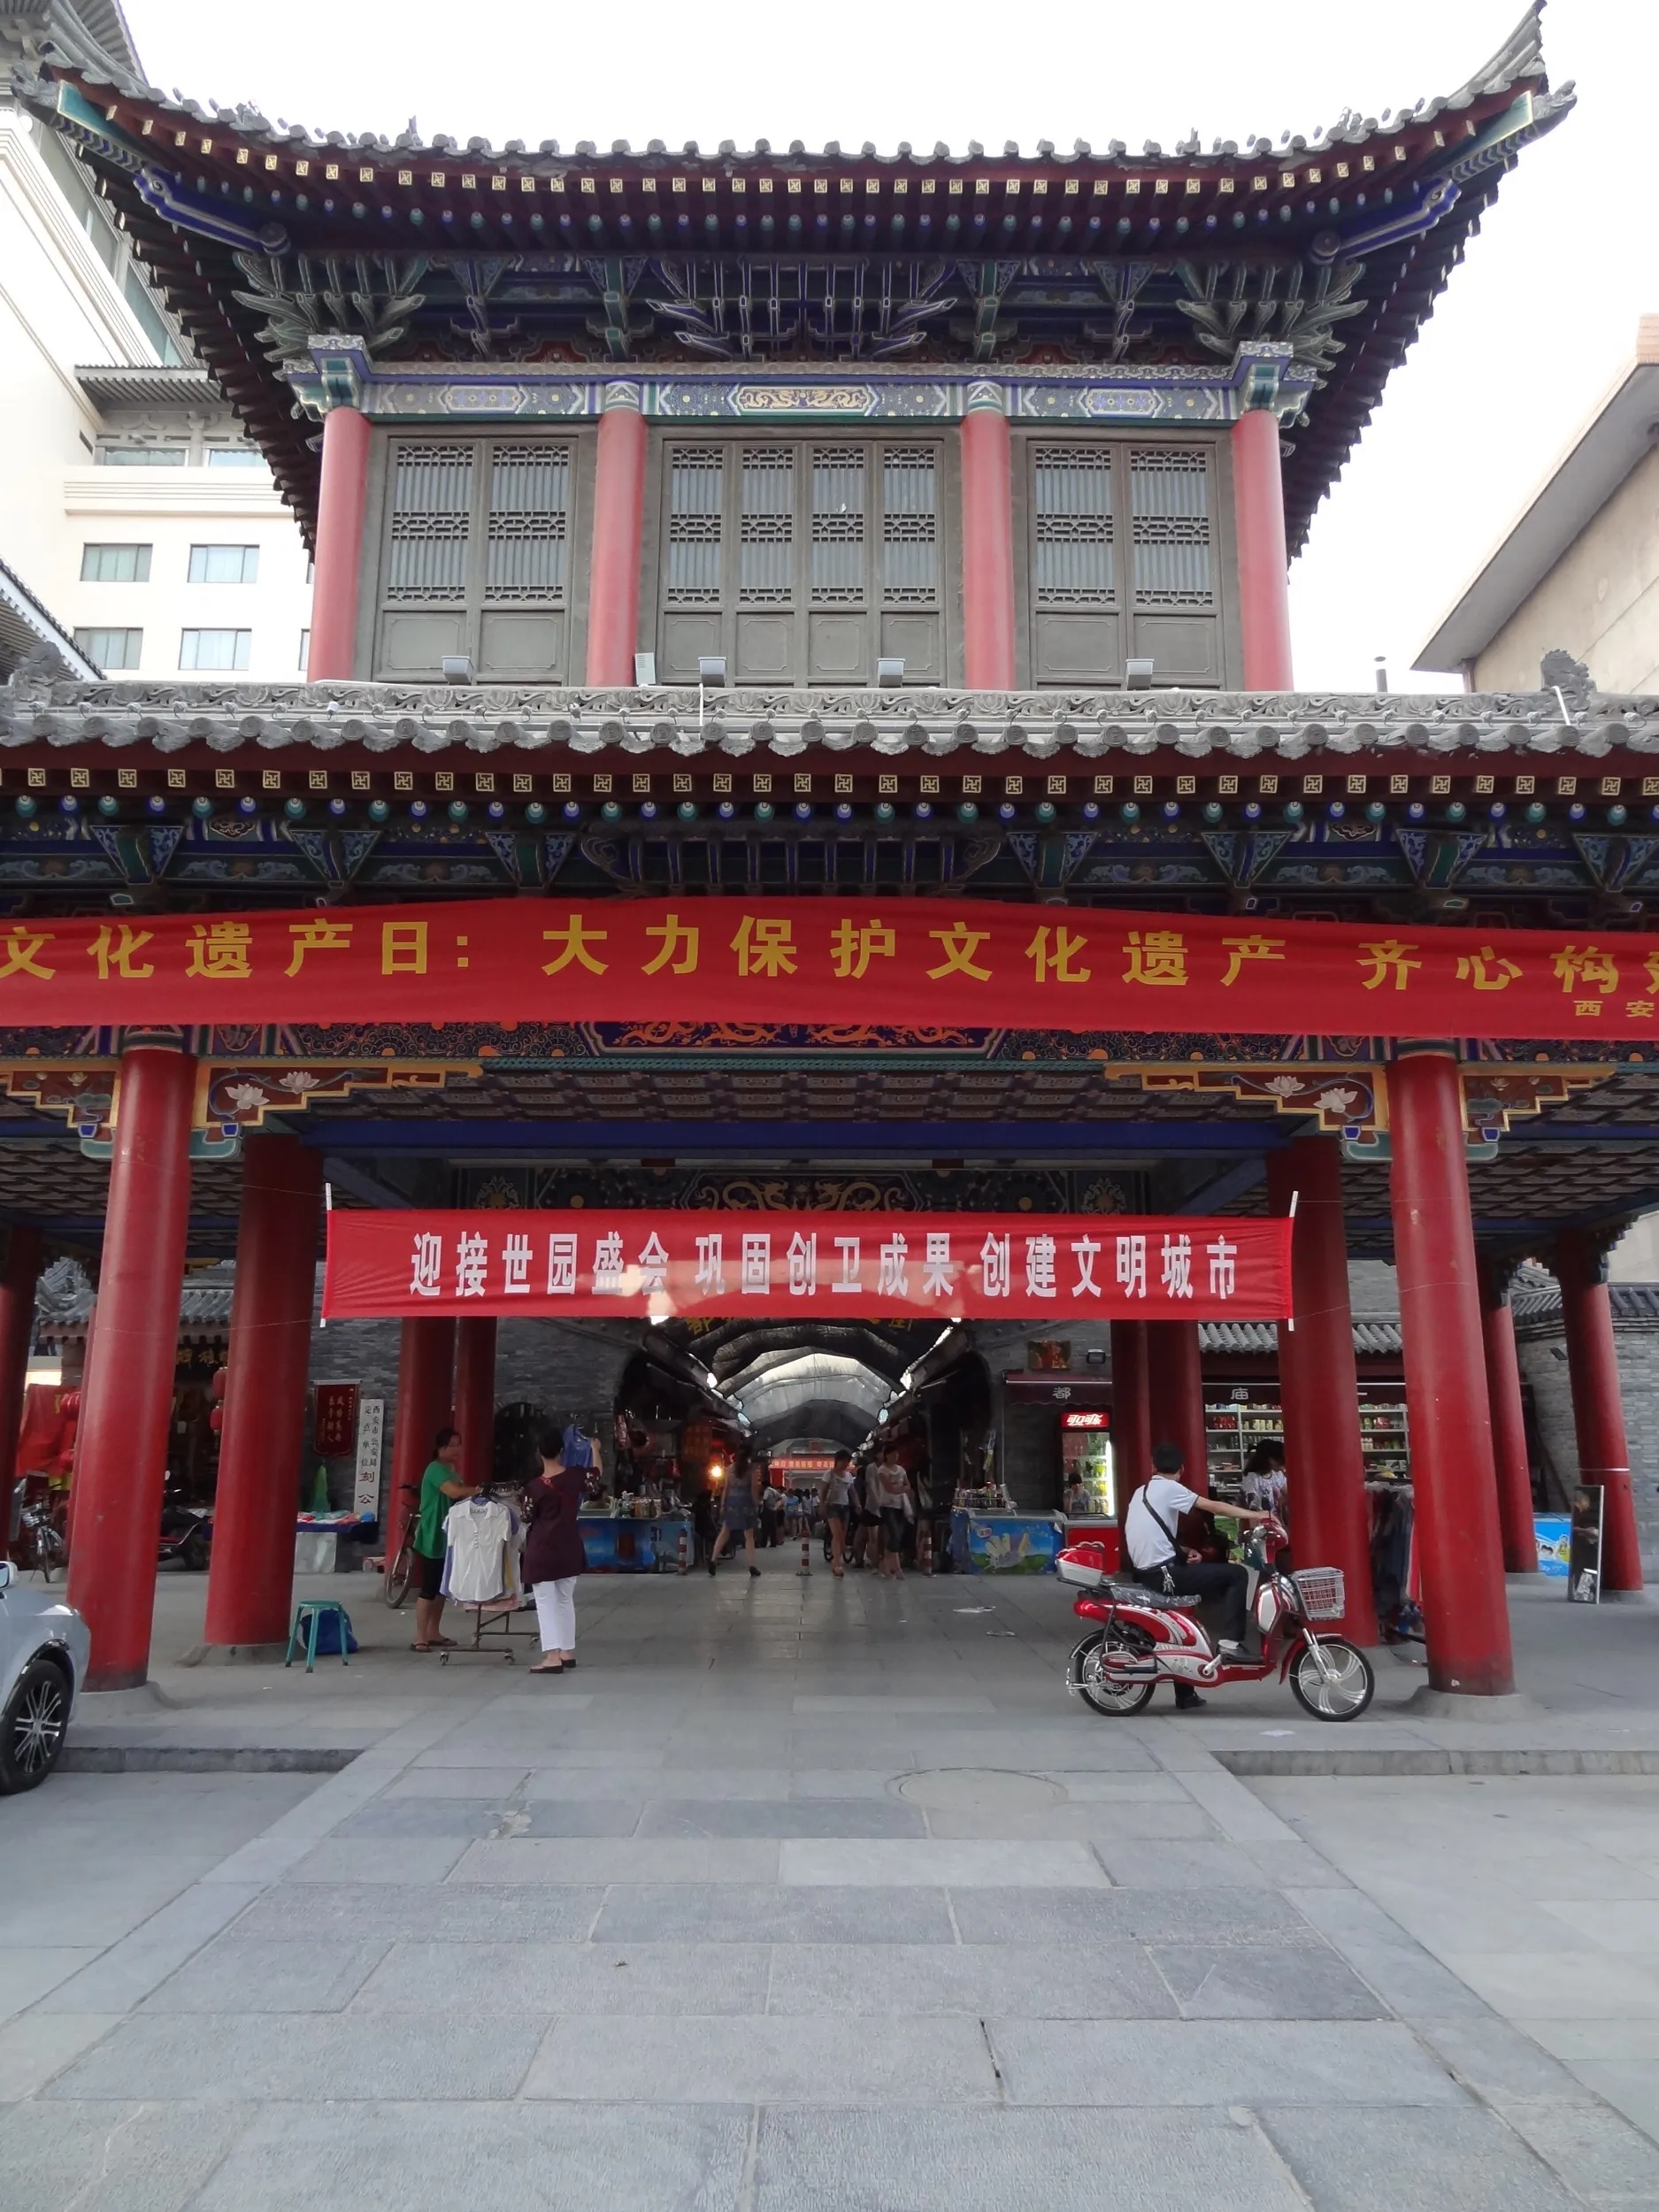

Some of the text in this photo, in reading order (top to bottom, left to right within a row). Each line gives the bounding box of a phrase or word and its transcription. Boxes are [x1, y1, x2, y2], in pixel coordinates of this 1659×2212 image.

[1356, 939, 1659, 994] 齐心构
[1573, 1000, 1655, 1018] 西安
[409, 1231, 1237, 1300] 迎接世园盛会 巩固创卫成果 创建文明城市
